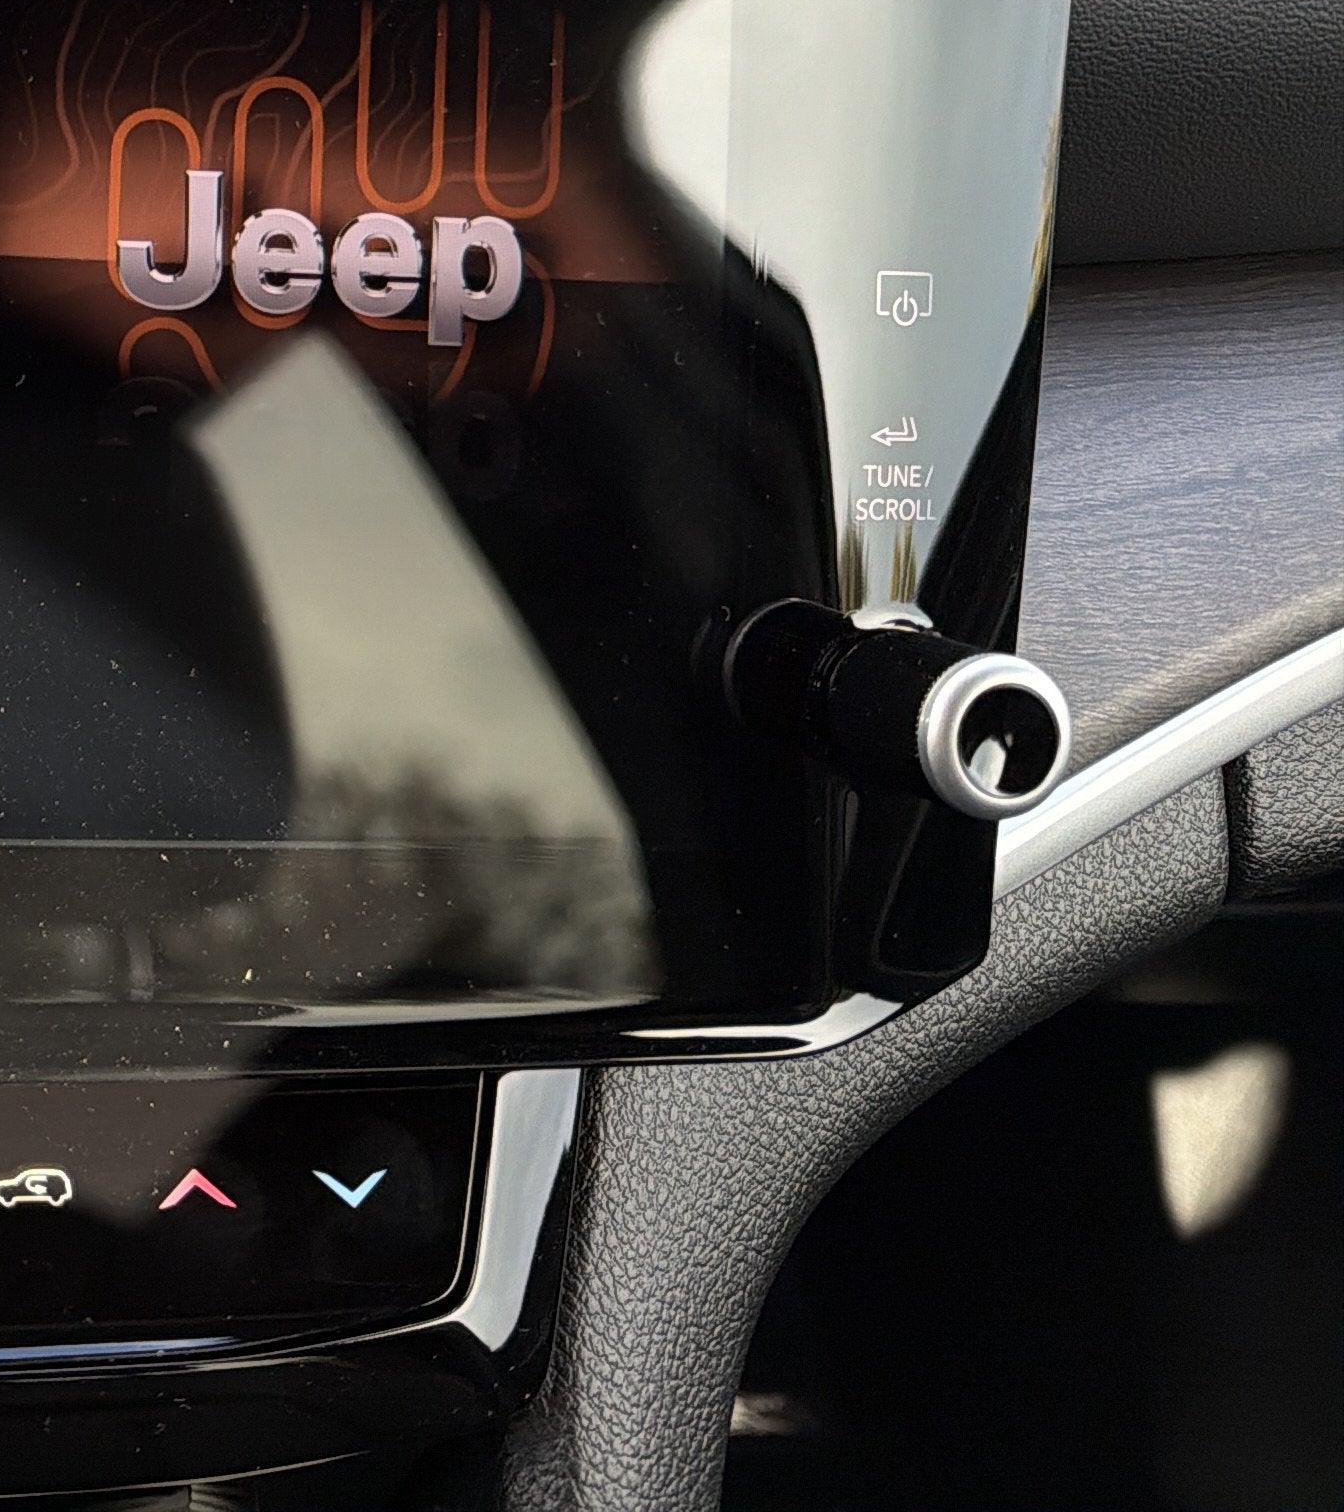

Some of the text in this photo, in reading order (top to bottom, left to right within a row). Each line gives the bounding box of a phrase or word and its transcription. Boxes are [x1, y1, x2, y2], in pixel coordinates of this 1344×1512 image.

[116, 169, 524, 347] Jeep
[862, 464, 935, 488] TUNE/
[855, 497, 937, 521] SCROLL
